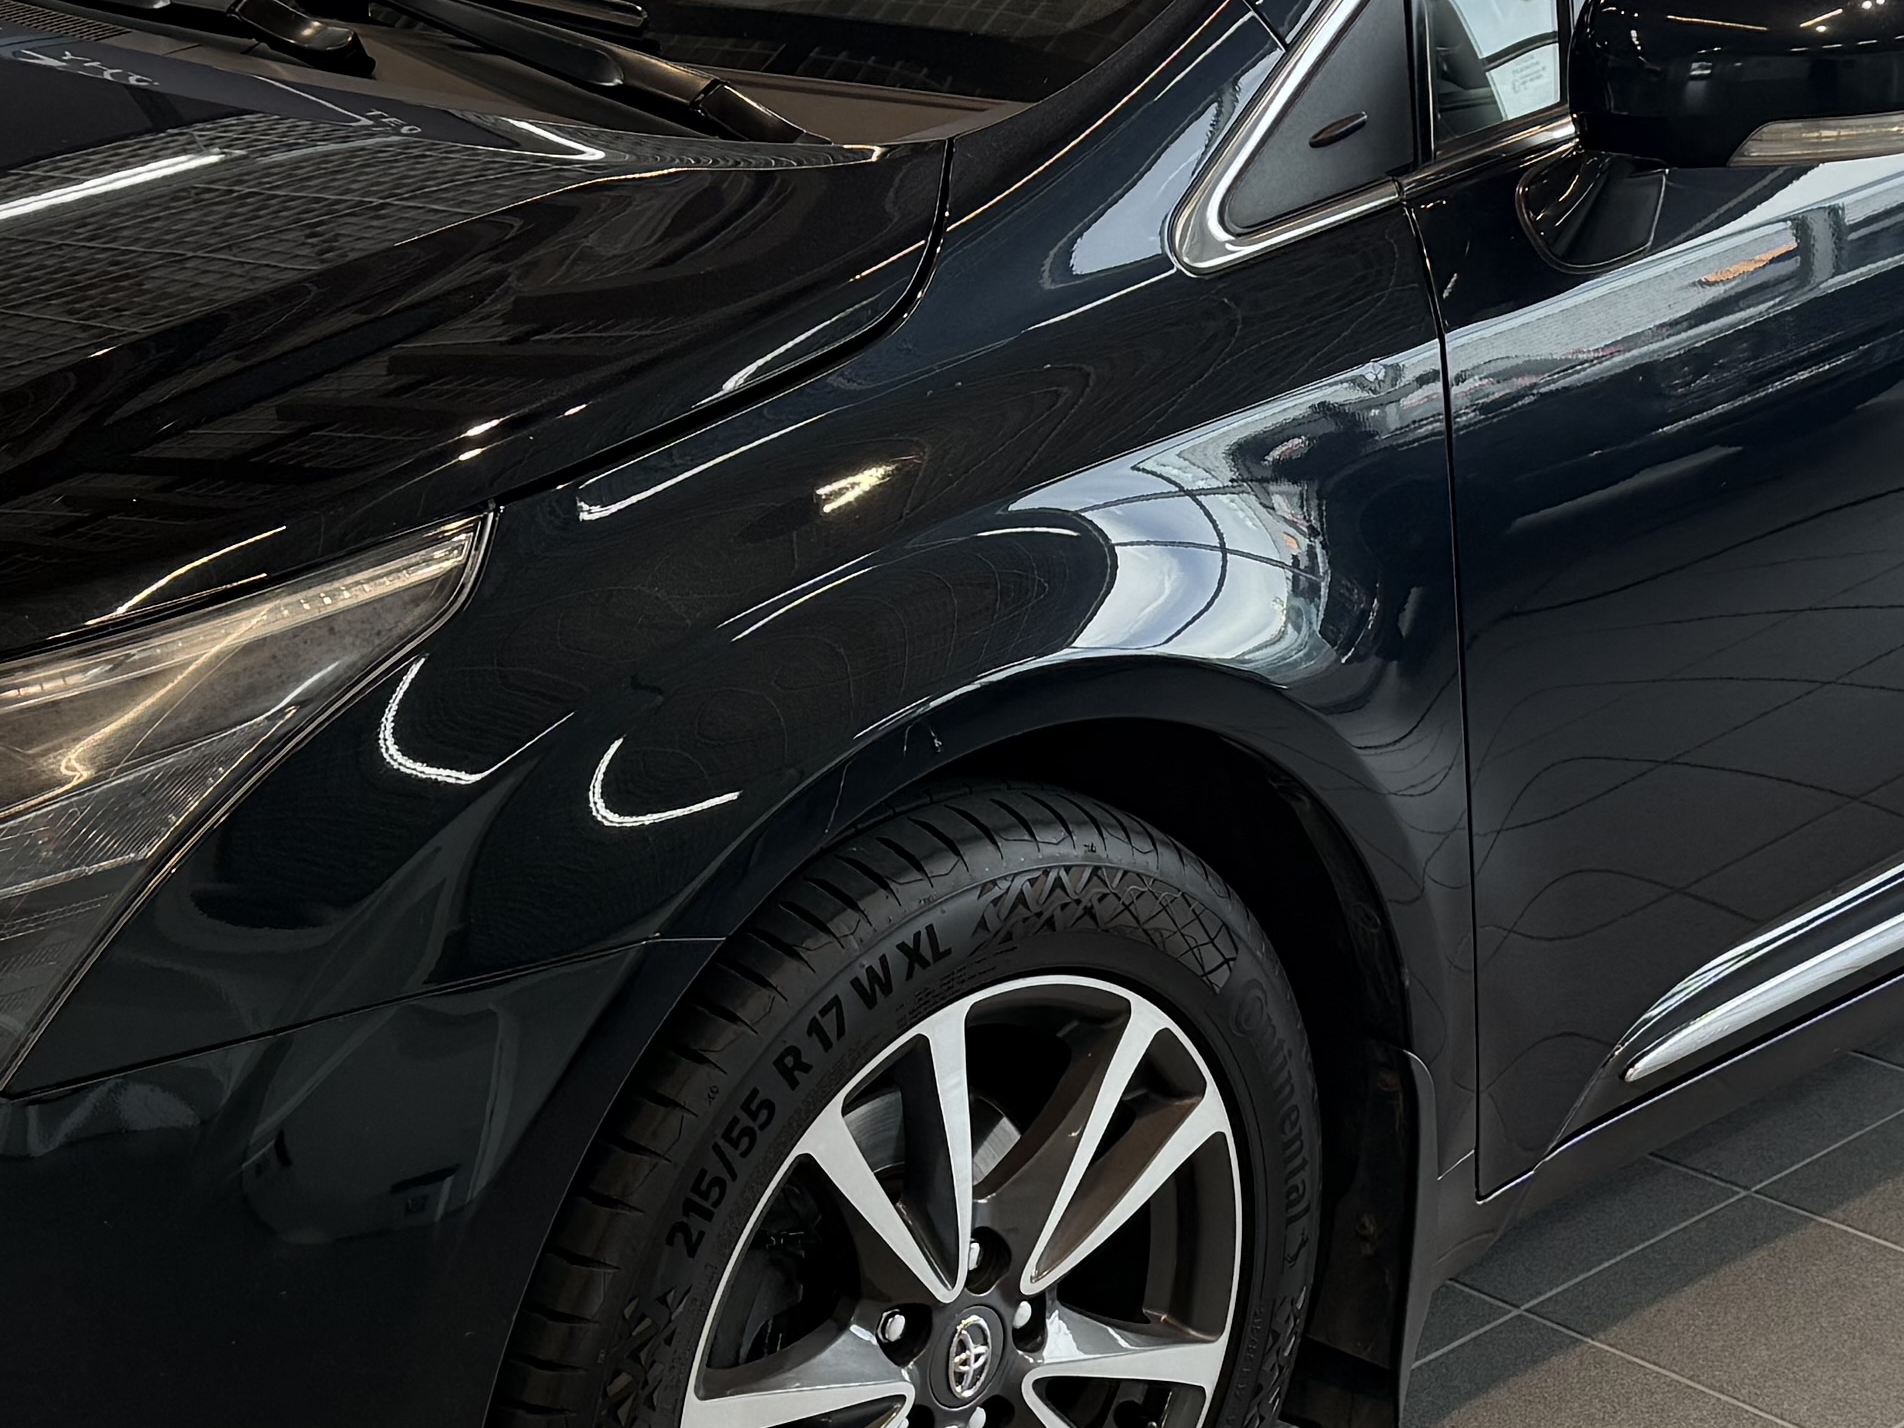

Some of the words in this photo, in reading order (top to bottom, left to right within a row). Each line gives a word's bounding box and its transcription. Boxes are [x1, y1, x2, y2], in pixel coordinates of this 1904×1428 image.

[664, 1087, 778, 1259] 215/55
[772, 1044, 814, 1092] R
[805, 993, 847, 1053] 17
[849, 952, 895, 1011] W
[895, 922, 953, 982] XL
